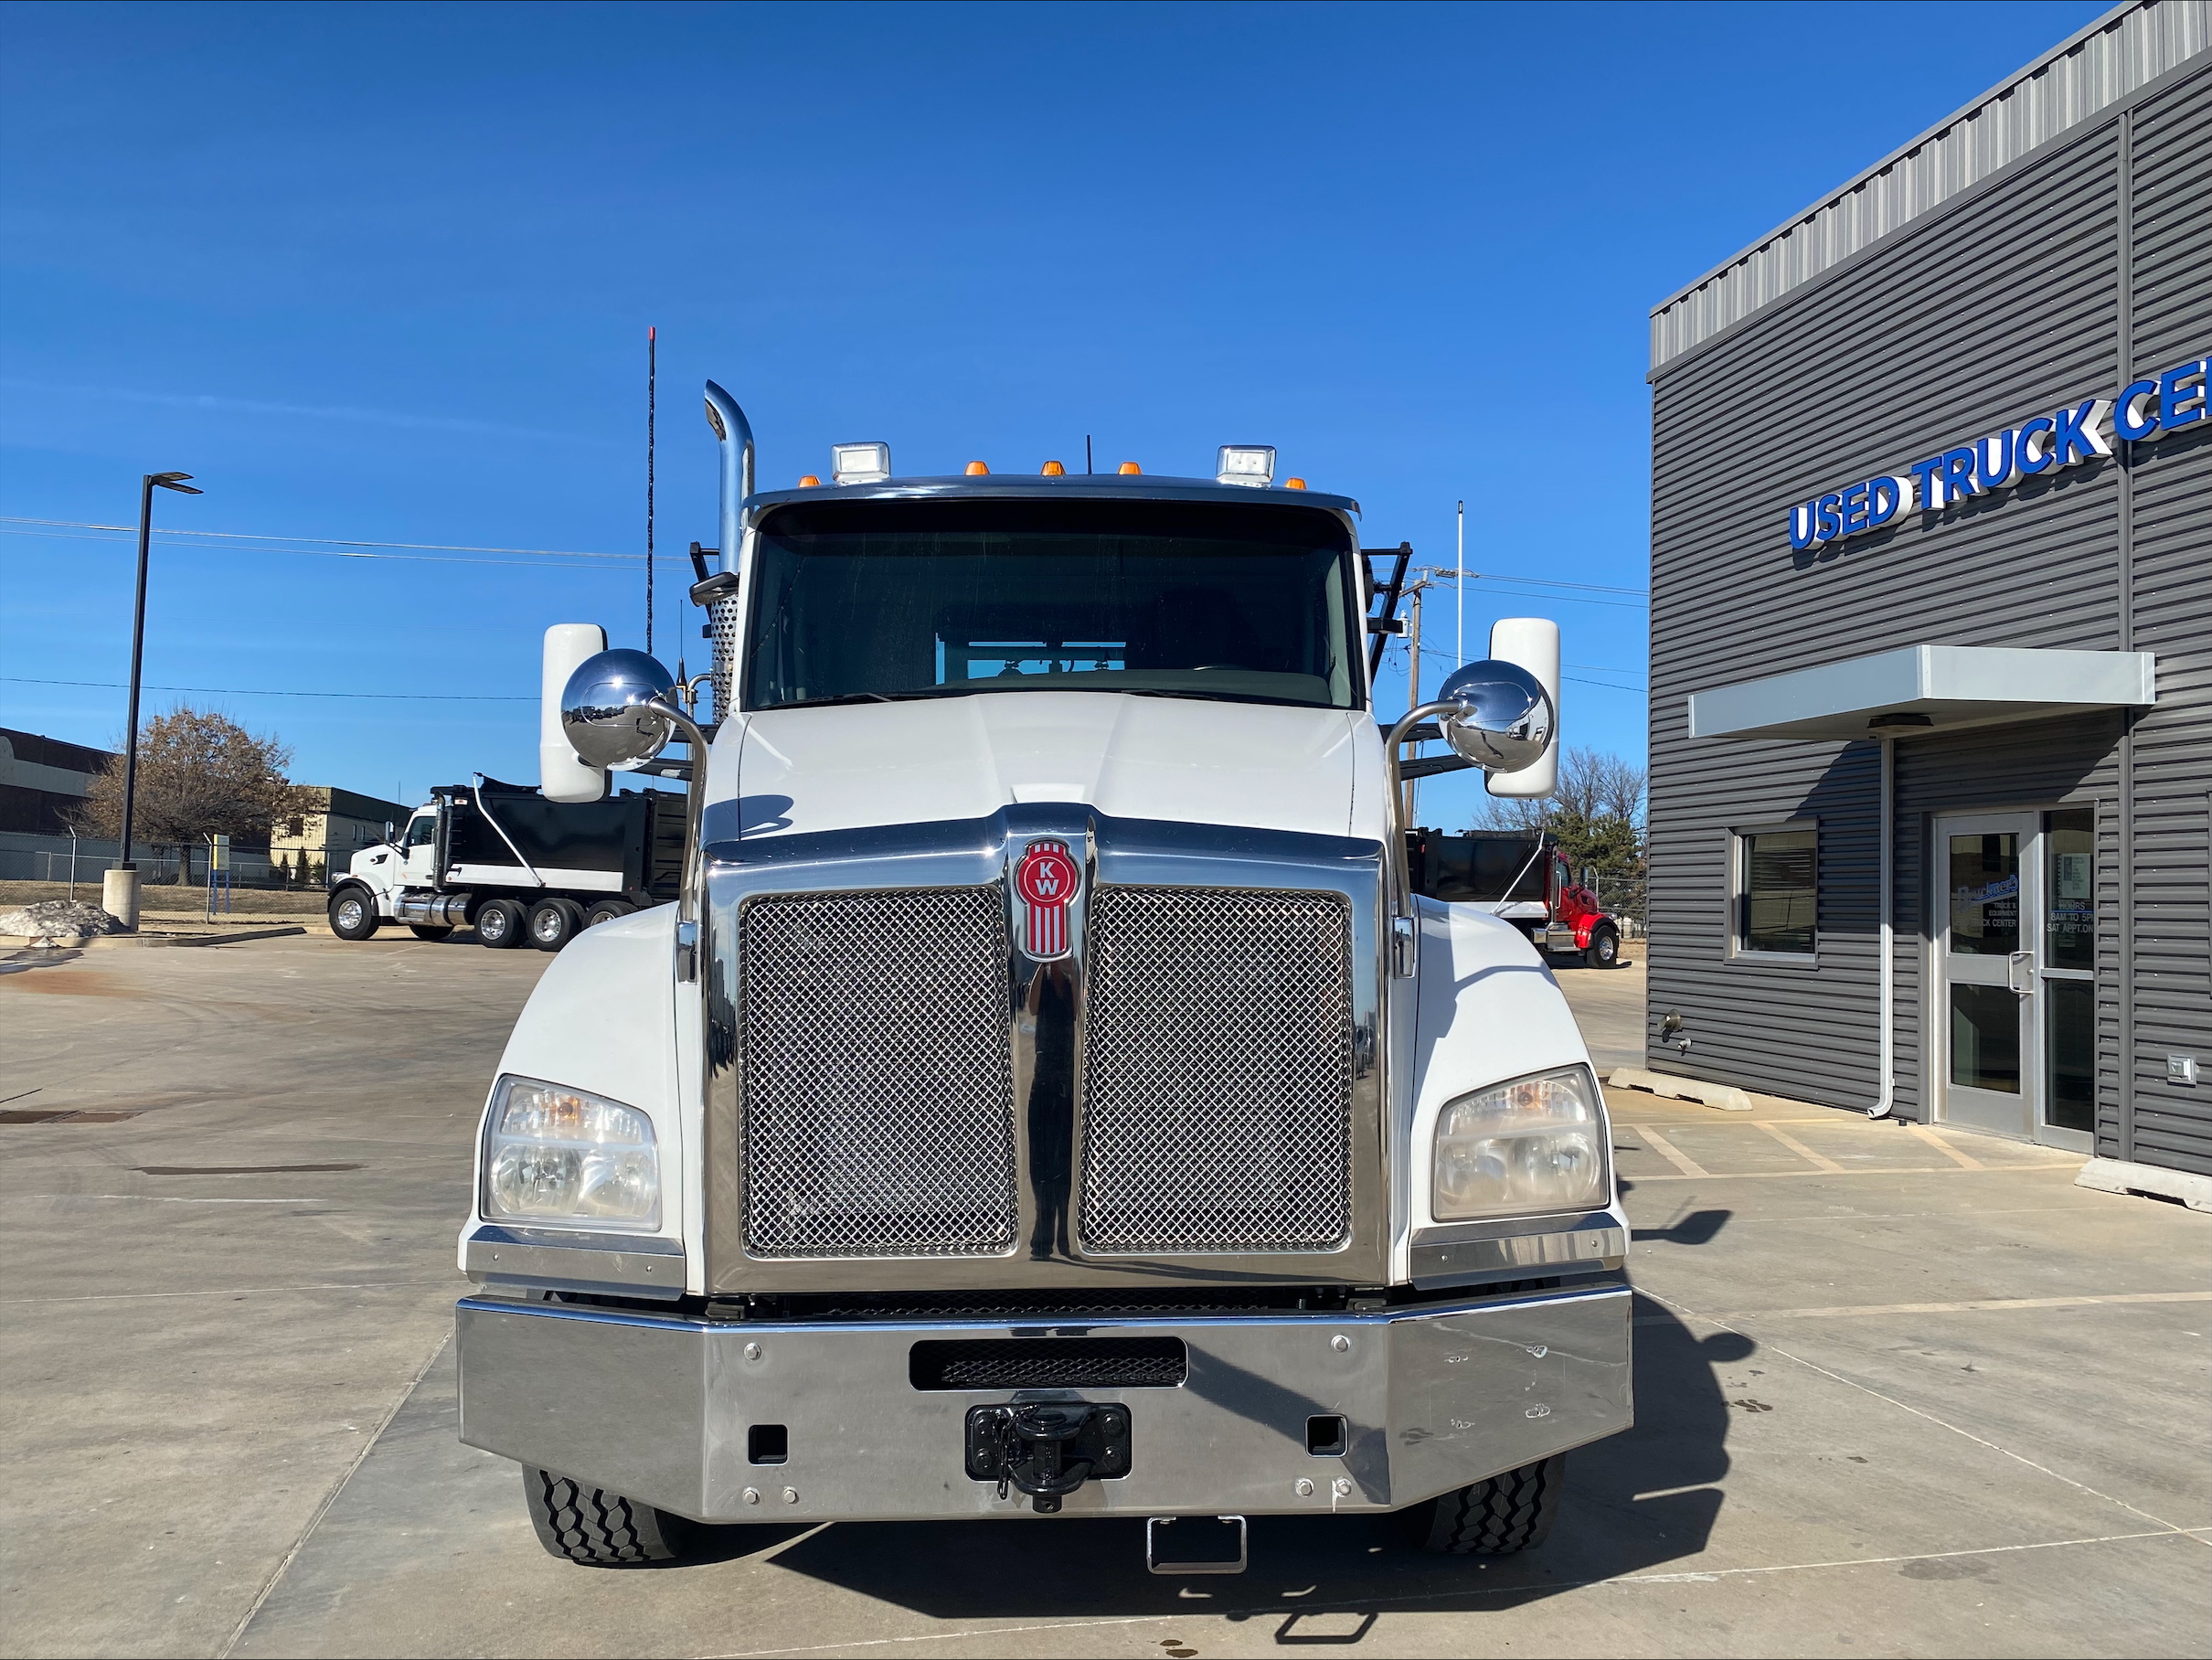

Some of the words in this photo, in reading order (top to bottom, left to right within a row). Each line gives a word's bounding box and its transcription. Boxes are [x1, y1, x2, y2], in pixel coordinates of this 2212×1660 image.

[1790, 475, 1902, 549] USED
[1911, 399, 2099, 510] TRUCK
[2113, 356, 2212, 442] CE
[2058, 901, 2086, 910] HOURS
[2050, 912, 2067, 921] 8AM
[2069, 912, 2079, 922] TO
[1992, 919, 2017, 927] CENTER
[2047, 923, 2060, 932] SAT
